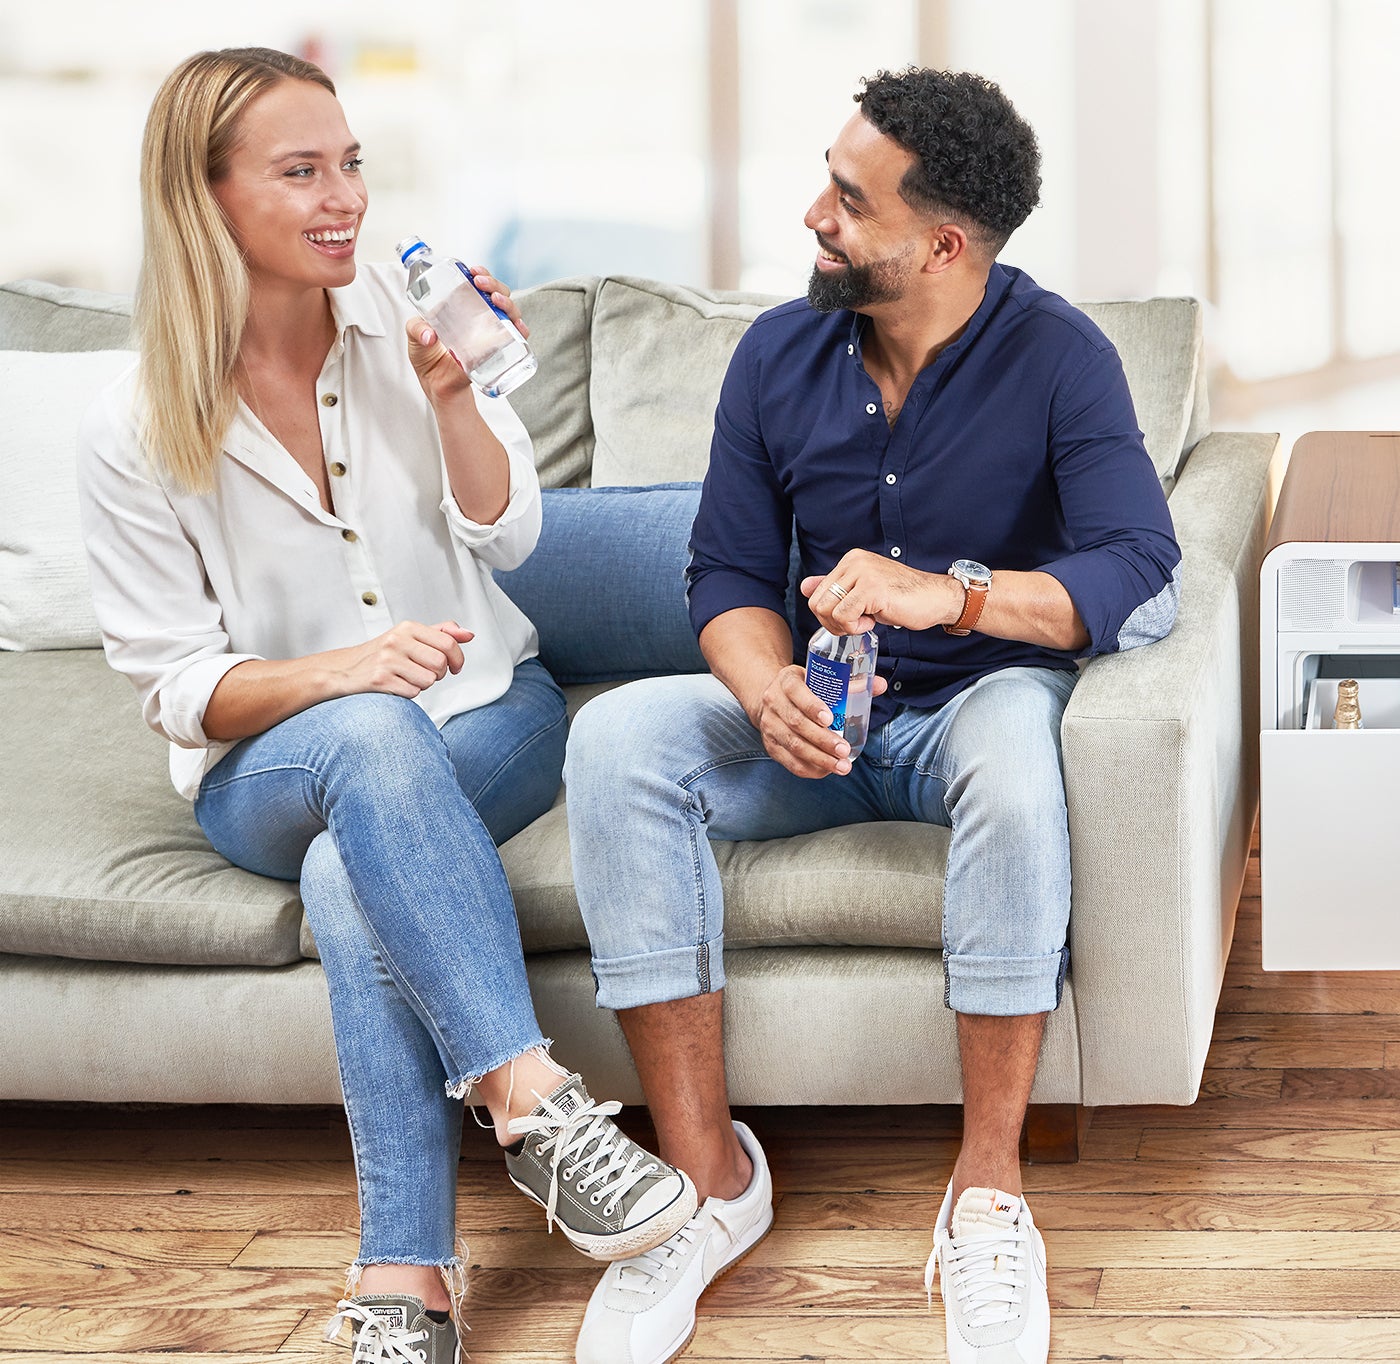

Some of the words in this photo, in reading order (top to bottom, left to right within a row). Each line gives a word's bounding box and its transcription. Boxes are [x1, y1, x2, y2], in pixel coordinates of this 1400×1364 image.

[811, 663, 824, 672] SOLID
[823, 668, 837, 677] ROCK
[561, 1100, 578, 1116] STAR
